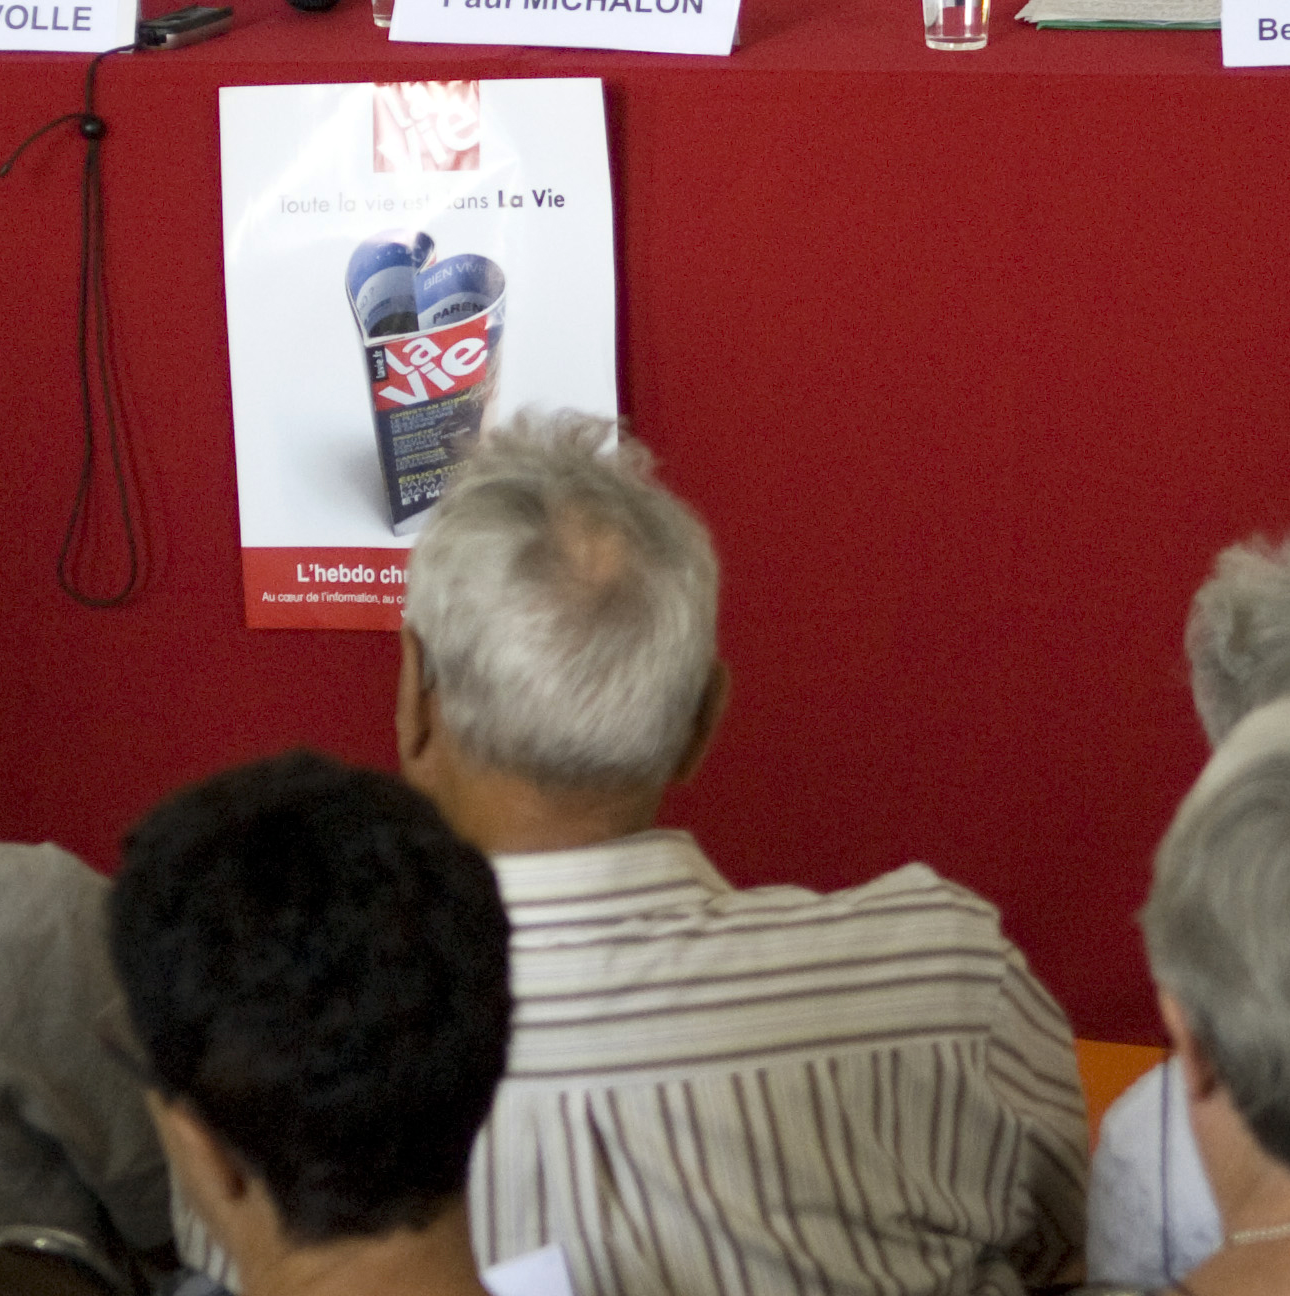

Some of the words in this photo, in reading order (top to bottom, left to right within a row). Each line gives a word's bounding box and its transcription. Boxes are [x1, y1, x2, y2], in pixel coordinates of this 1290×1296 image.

[339, 192, 356, 212] la
[365, 192, 395, 212] vie
[446, 190, 488, 209] ans
[498, 189, 523, 208] La
[532, 188, 566, 208] Vie
[423, 265, 453, 291] BIEN
[297, 563, 375, 583] L'hebdo
[262, 591, 276, 602] Au
[306, 591, 319, 602] de
[382, 594, 394, 604] au
